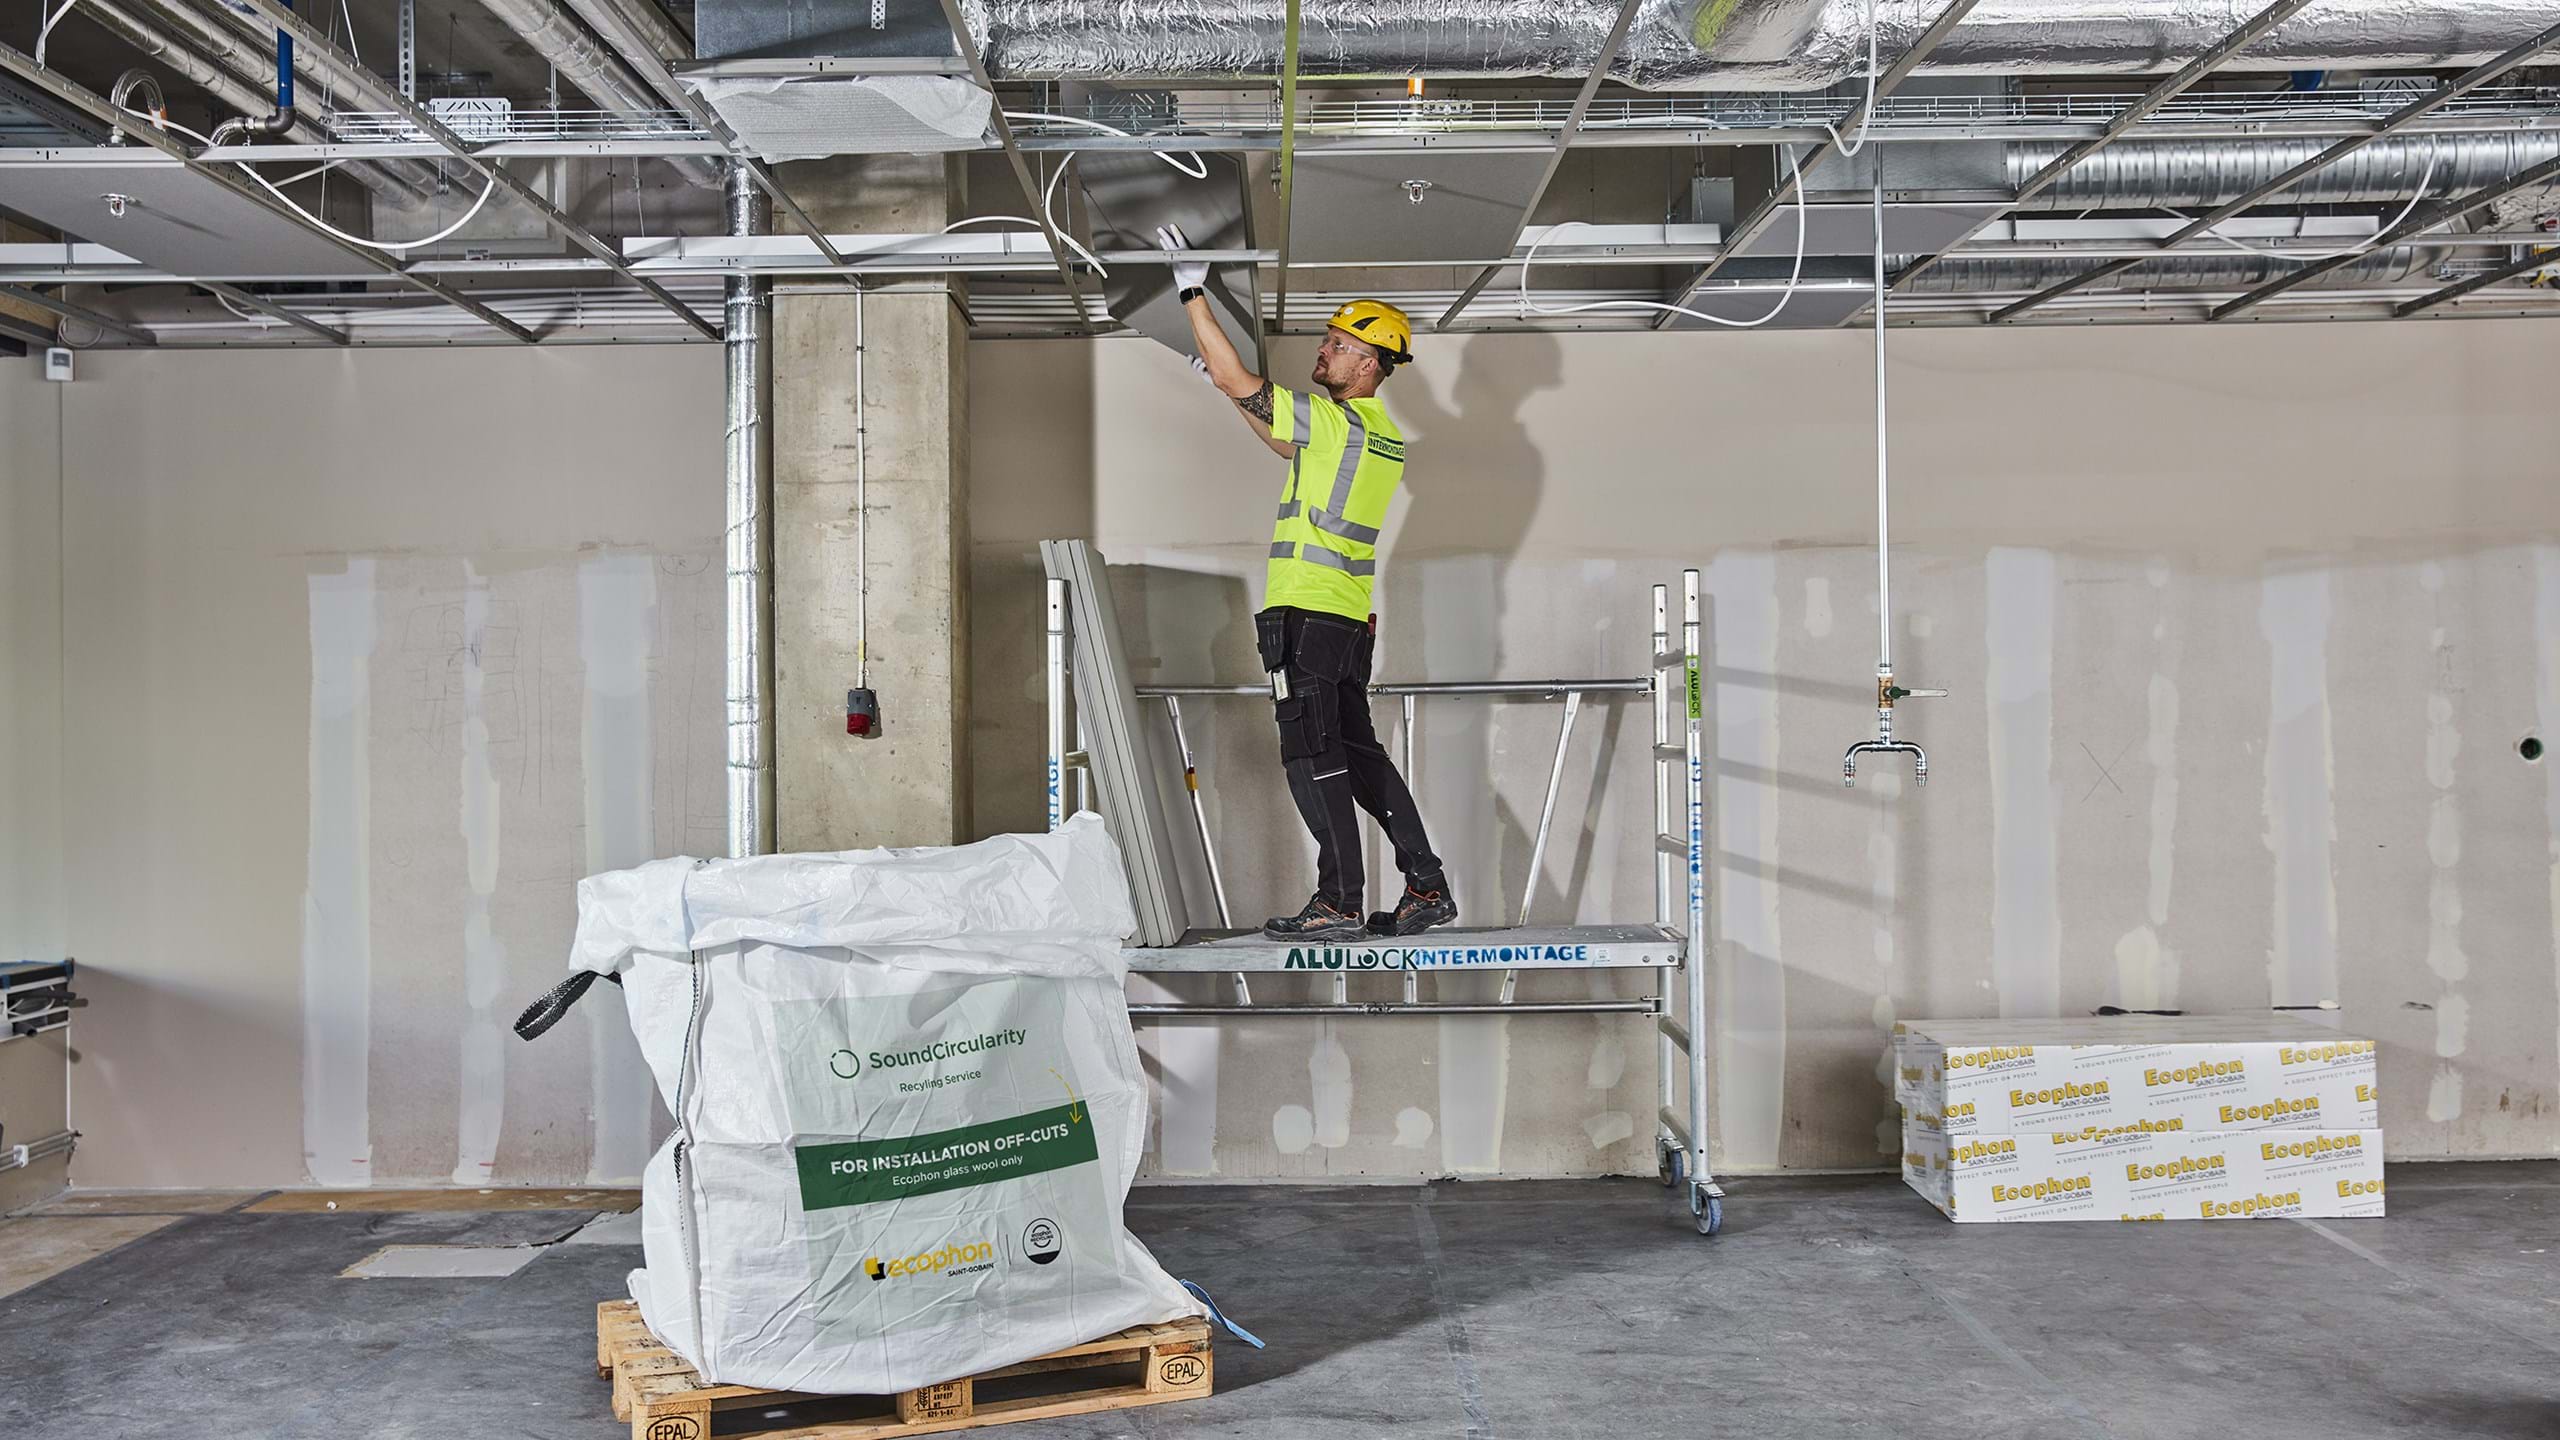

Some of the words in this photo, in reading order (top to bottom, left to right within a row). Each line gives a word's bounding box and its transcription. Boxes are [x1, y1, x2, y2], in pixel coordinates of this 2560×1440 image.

[1690, 670, 1700, 714] ALULOCK
[1284, 948, 1418, 970] ALULOCK
[1416, 945, 1587, 966] INTERMONTAGE
[869, 1027, 1027, 1070] SoundCircularity
[1987, 1057, 2035, 1072] SAINT-GOBAIN
[2144, 1059, 2244, 1087] Ecophon
[899, 1077, 943, 1093] Recyling
[945, 1069, 982, 1085] Service
[2195, 1074, 2245, 1087] SAINT-GOBAIN
[2009, 1080, 2109, 1107] Ecophon
[2060, 1095, 2110, 1108] SAINT-GOBAIN
[2087, 1107, 2112, 1117] PEOPLE
[2219, 1097, 2319, 1123] Ecophon
[2271, 1111, 2320, 1124] SAINT-GOBAIN
[830, 1158, 868, 1175] FOR
[872, 1139, 990, 1171] INSTALLATION
[994, 1123, 1069, 1150] OFF-CUTS
[2103, 1133, 2152, 1146] SAINT-GOBAIN
[2260, 1134, 2361, 1161] Ecophon
[1968, 1152, 2018, 1166] SAINT-GOBAIN
[2312, 1147, 2363, 1161] SAINT-GOBAIN
[892, 1169, 941, 1187] Ecophon
[943, 1164, 969, 1180] glass
[972, 1157, 999, 1173] wool
[1001, 1153, 1023, 1168] only
[2126, 1154, 2225, 1181] Ecophon
[2176, 1168, 2226, 1182] SAINT-GOBAIN
[1992, 1175, 2091, 1202] Ecophon
[2043, 1190, 2093, 1203] SAINT-GOBAIN
[2201, 1191, 2300, 1218] Ecophon
[888, 1241, 992, 1278] ecophon
[947, 1262, 994, 1277] SAINT-GOBAIN
[1166, 1361, 1199, 1380] EPAL
[654, 1422, 692, 1440] EPAL
